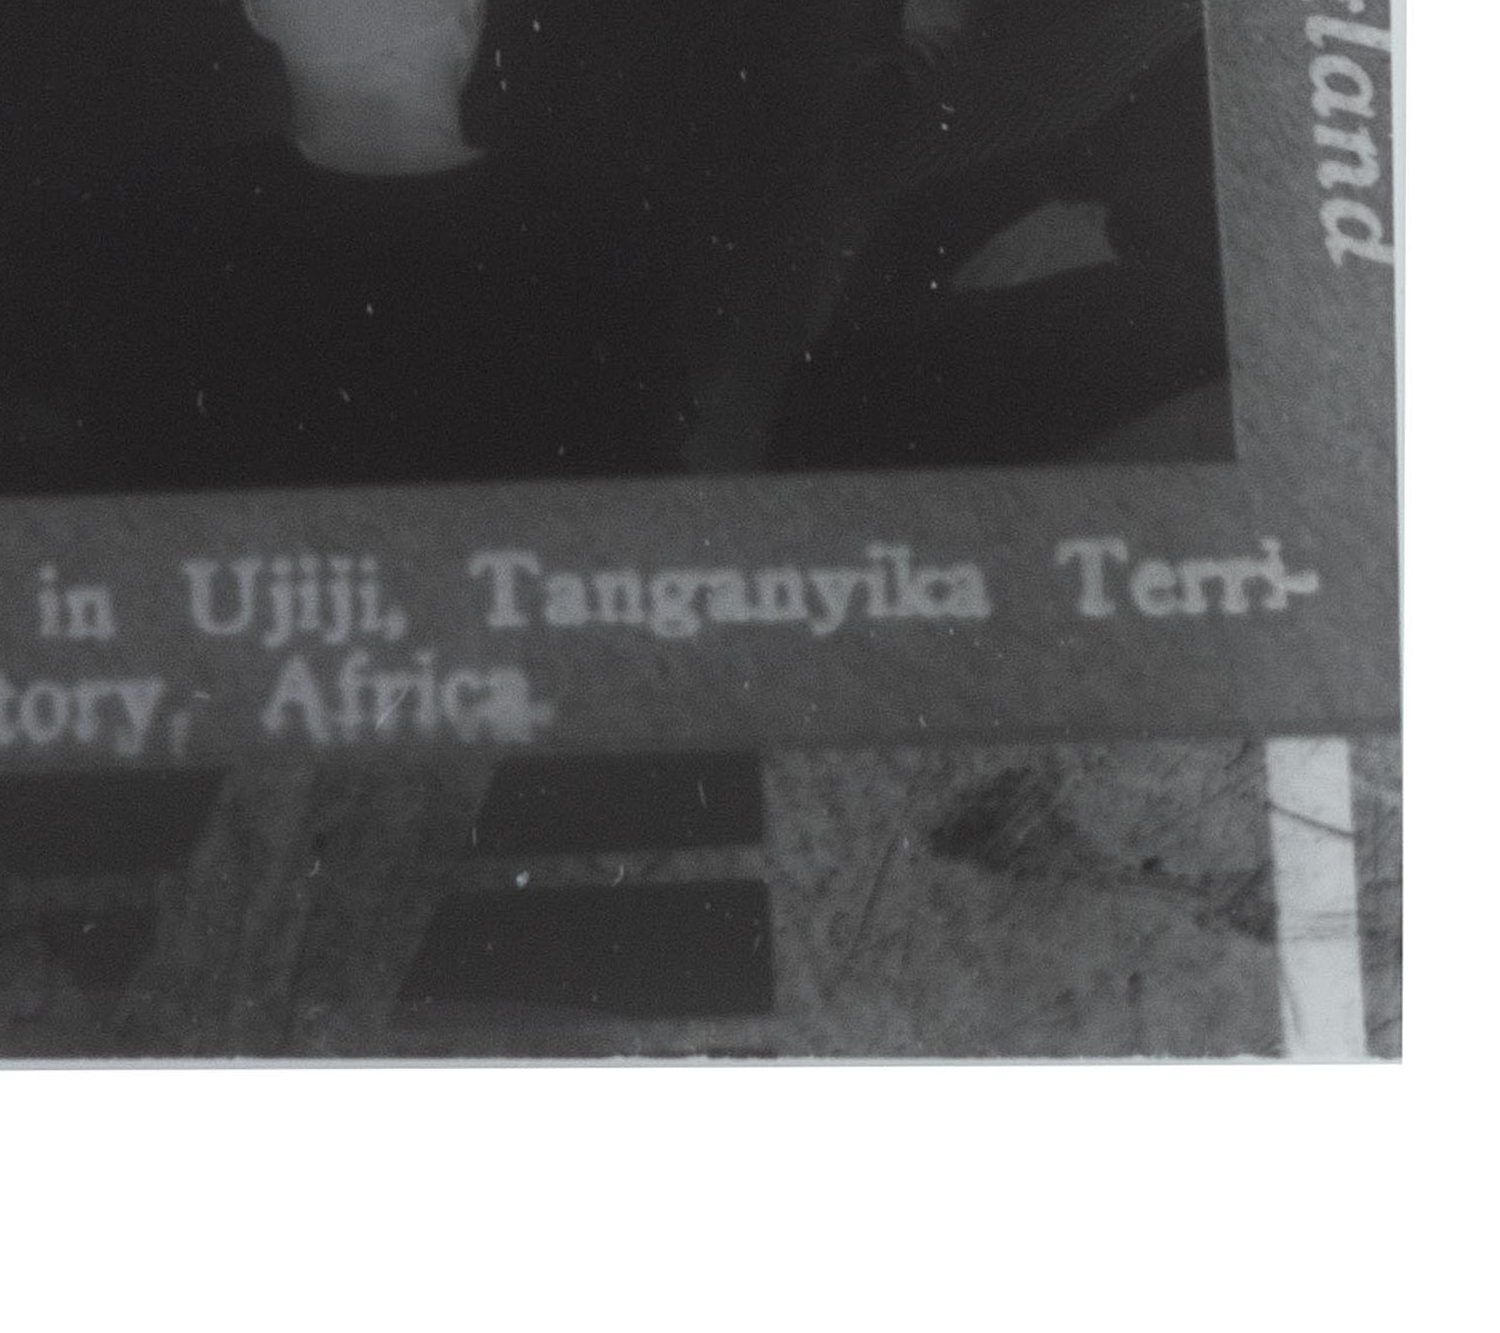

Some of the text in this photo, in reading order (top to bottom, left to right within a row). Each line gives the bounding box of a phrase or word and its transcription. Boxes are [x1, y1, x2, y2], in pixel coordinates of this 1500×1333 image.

[35, 560, 118, 642] in
[182, 545, 408, 651] Ujiji,
[464, 538, 993, 641] Tanganyika
[1053, 534, 1323, 621] Terri-
[257, 645, 556, 746] Africa.
